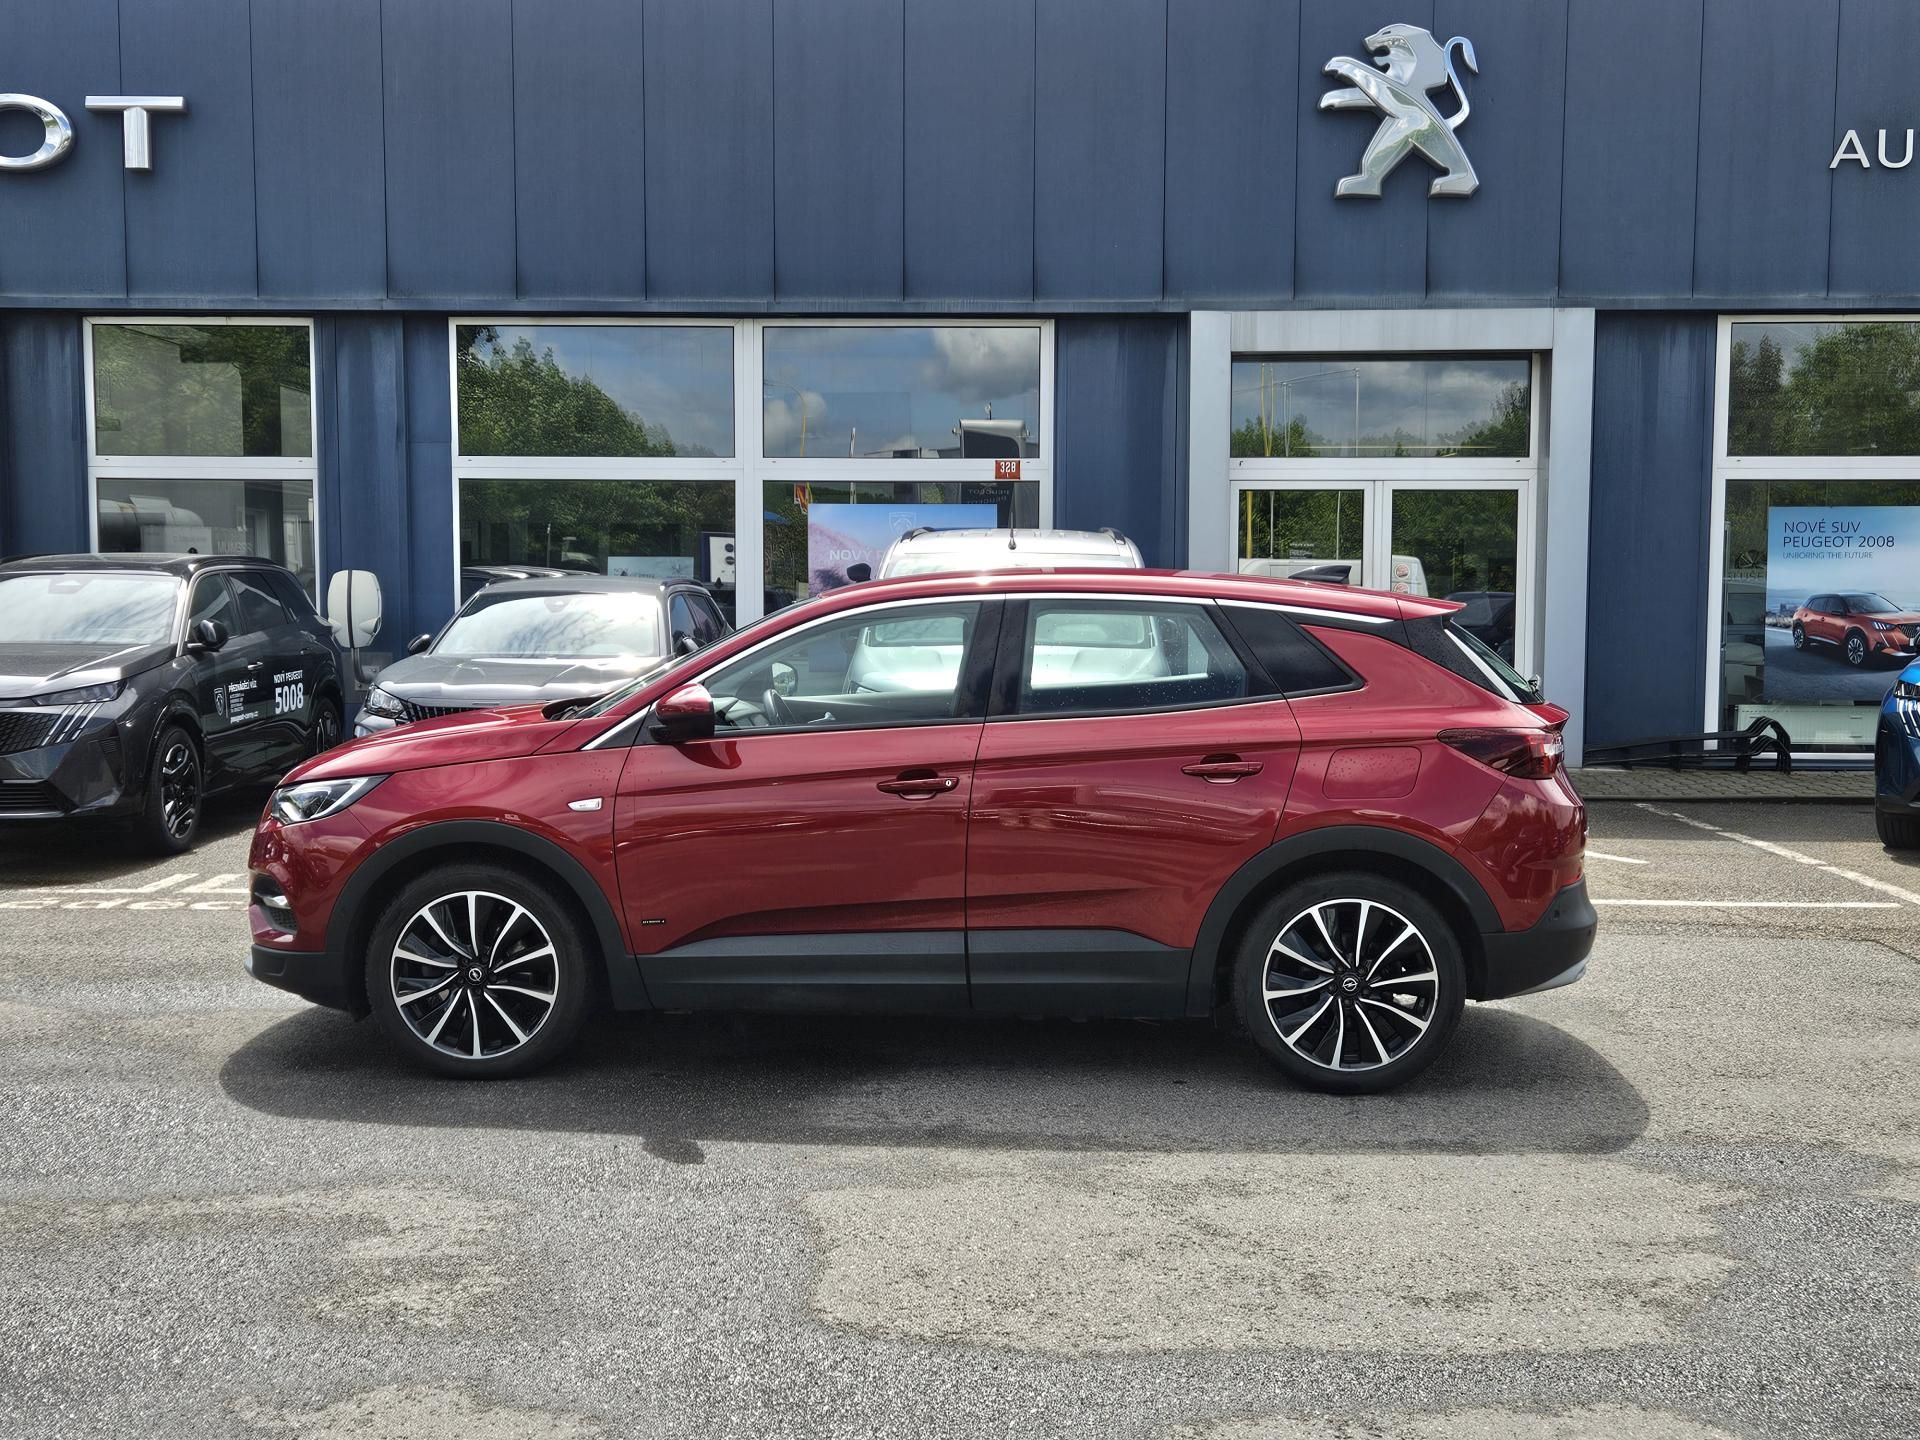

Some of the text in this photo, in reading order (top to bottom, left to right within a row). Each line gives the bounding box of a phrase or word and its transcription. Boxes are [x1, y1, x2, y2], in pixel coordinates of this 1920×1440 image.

[1829, 129, 1914, 168] AU
[1000, 461, 1016, 473] 328
[1784, 518, 1861, 533] NOVÉ SUV
[1783, 535, 1895, 548] PEUGEOT 2008
[1782, 551, 1873, 559] UNBORING THE FUTURE
[275, 682, 304, 715] 5008
